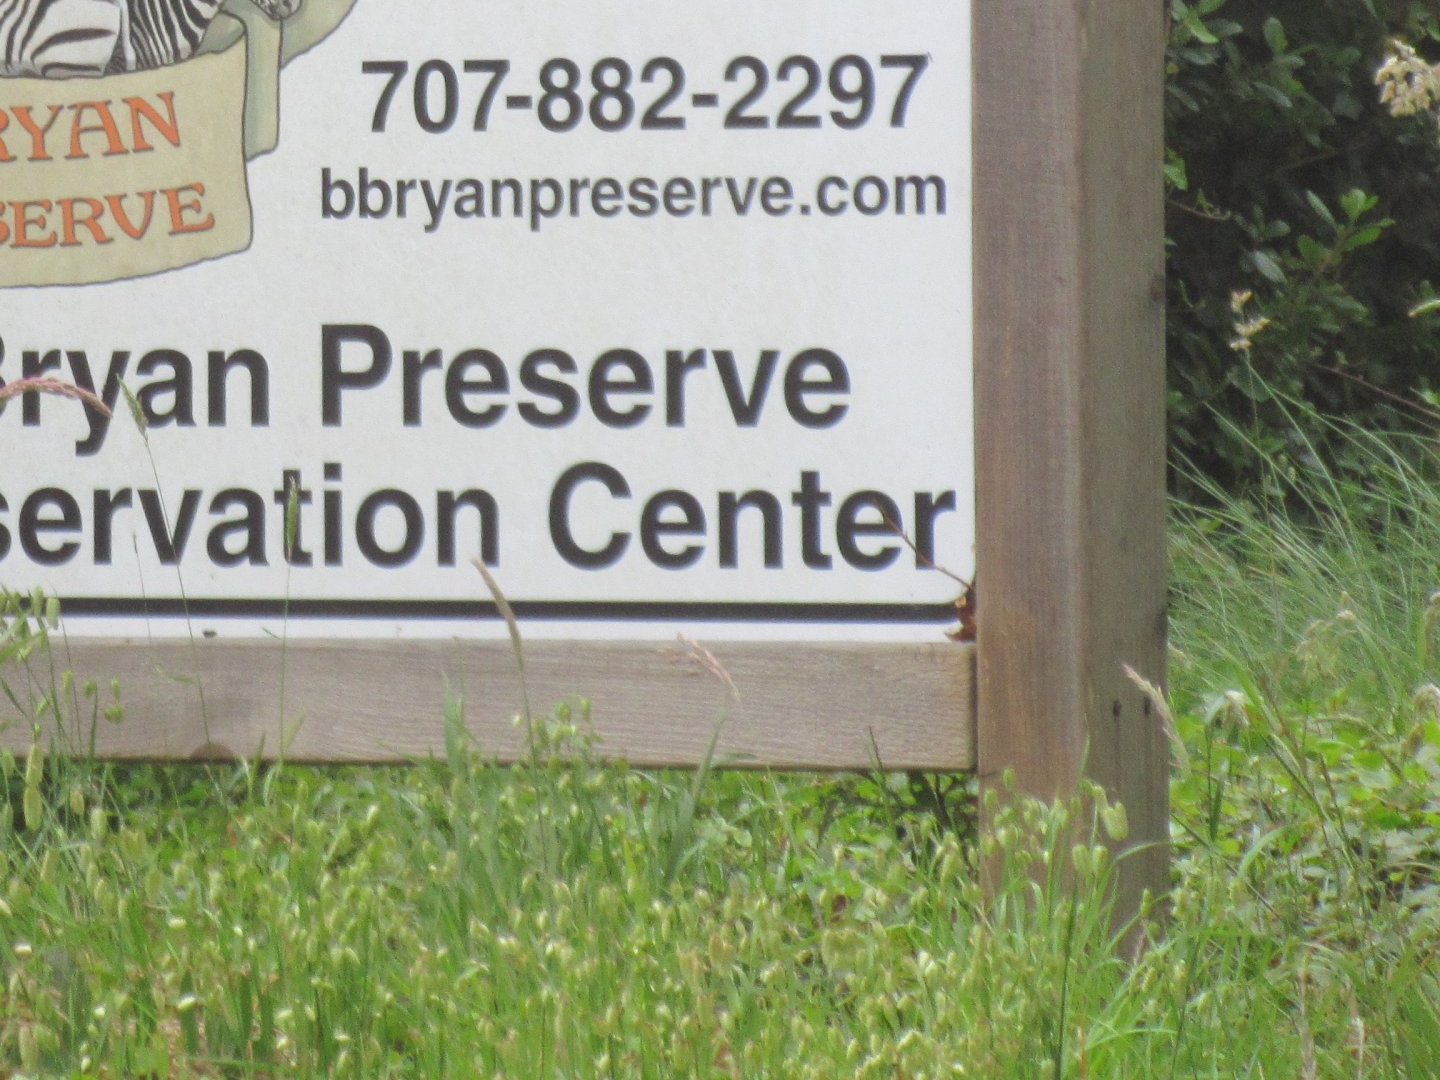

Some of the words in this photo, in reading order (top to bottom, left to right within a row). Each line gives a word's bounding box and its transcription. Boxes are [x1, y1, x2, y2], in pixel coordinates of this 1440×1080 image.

[362, 54, 927, 134] 707-882-2297
[321, 166, 946, 232] bbryanpreserve.com
[321, 323, 850, 429] Preserve
[547, 461, 956, 571] Center
